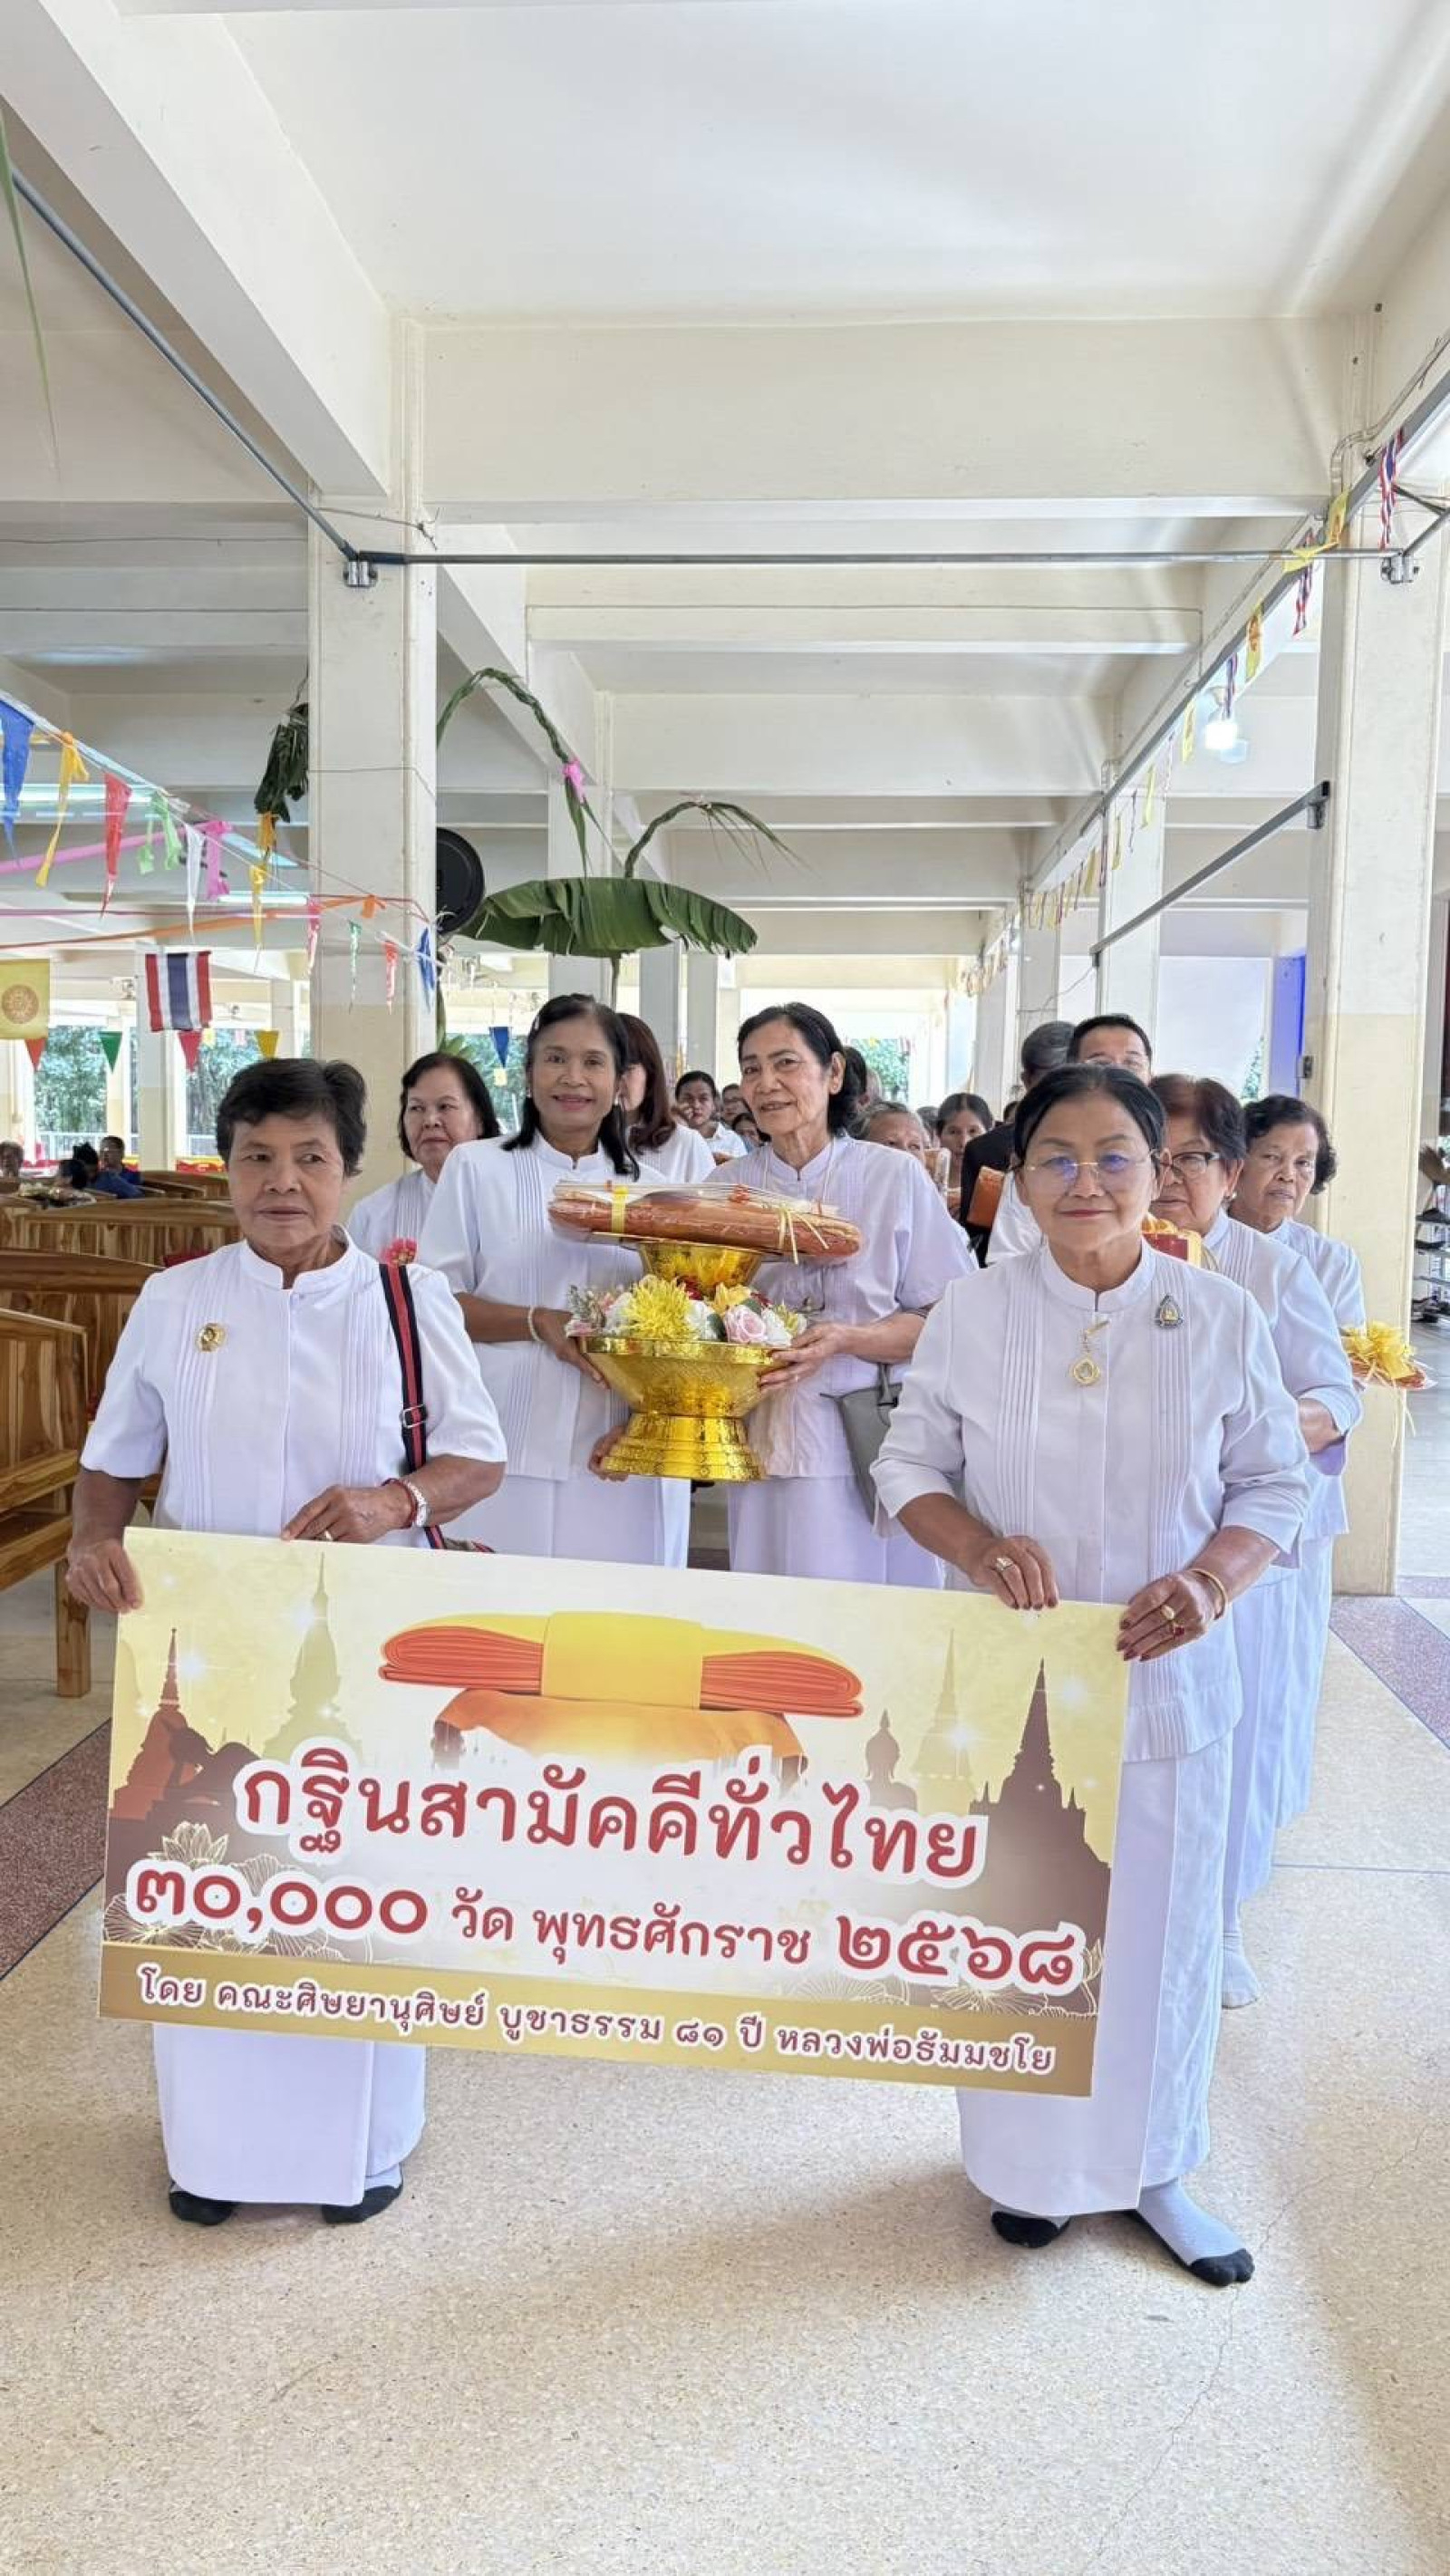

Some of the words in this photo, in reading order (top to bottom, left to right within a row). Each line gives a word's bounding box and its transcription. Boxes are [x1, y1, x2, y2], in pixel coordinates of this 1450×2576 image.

[244, 1747, 977, 1878] กฐินสามัคคีทั่วไทย
[137, 1867, 429, 1934] ๓๐,๐๐๐
[451, 1886, 514, 1941] วัด
[532, 1901, 811, 1965] พุทธศักราช
[836, 1915, 1076, 1986] ๒๕๖๘
[139, 1967, 202, 2002] โดย
[218, 1981, 485, 2031] คณะศิษยานุศิษย์
[500, 2005, 660, 2040] บูชาธรรม
[676, 2021, 724, 2047] ๘๑
[740, 2014, 763, 2049] ปี
[777, 2027, 1053, 2072] หลวงพ่อธัมมชโย
